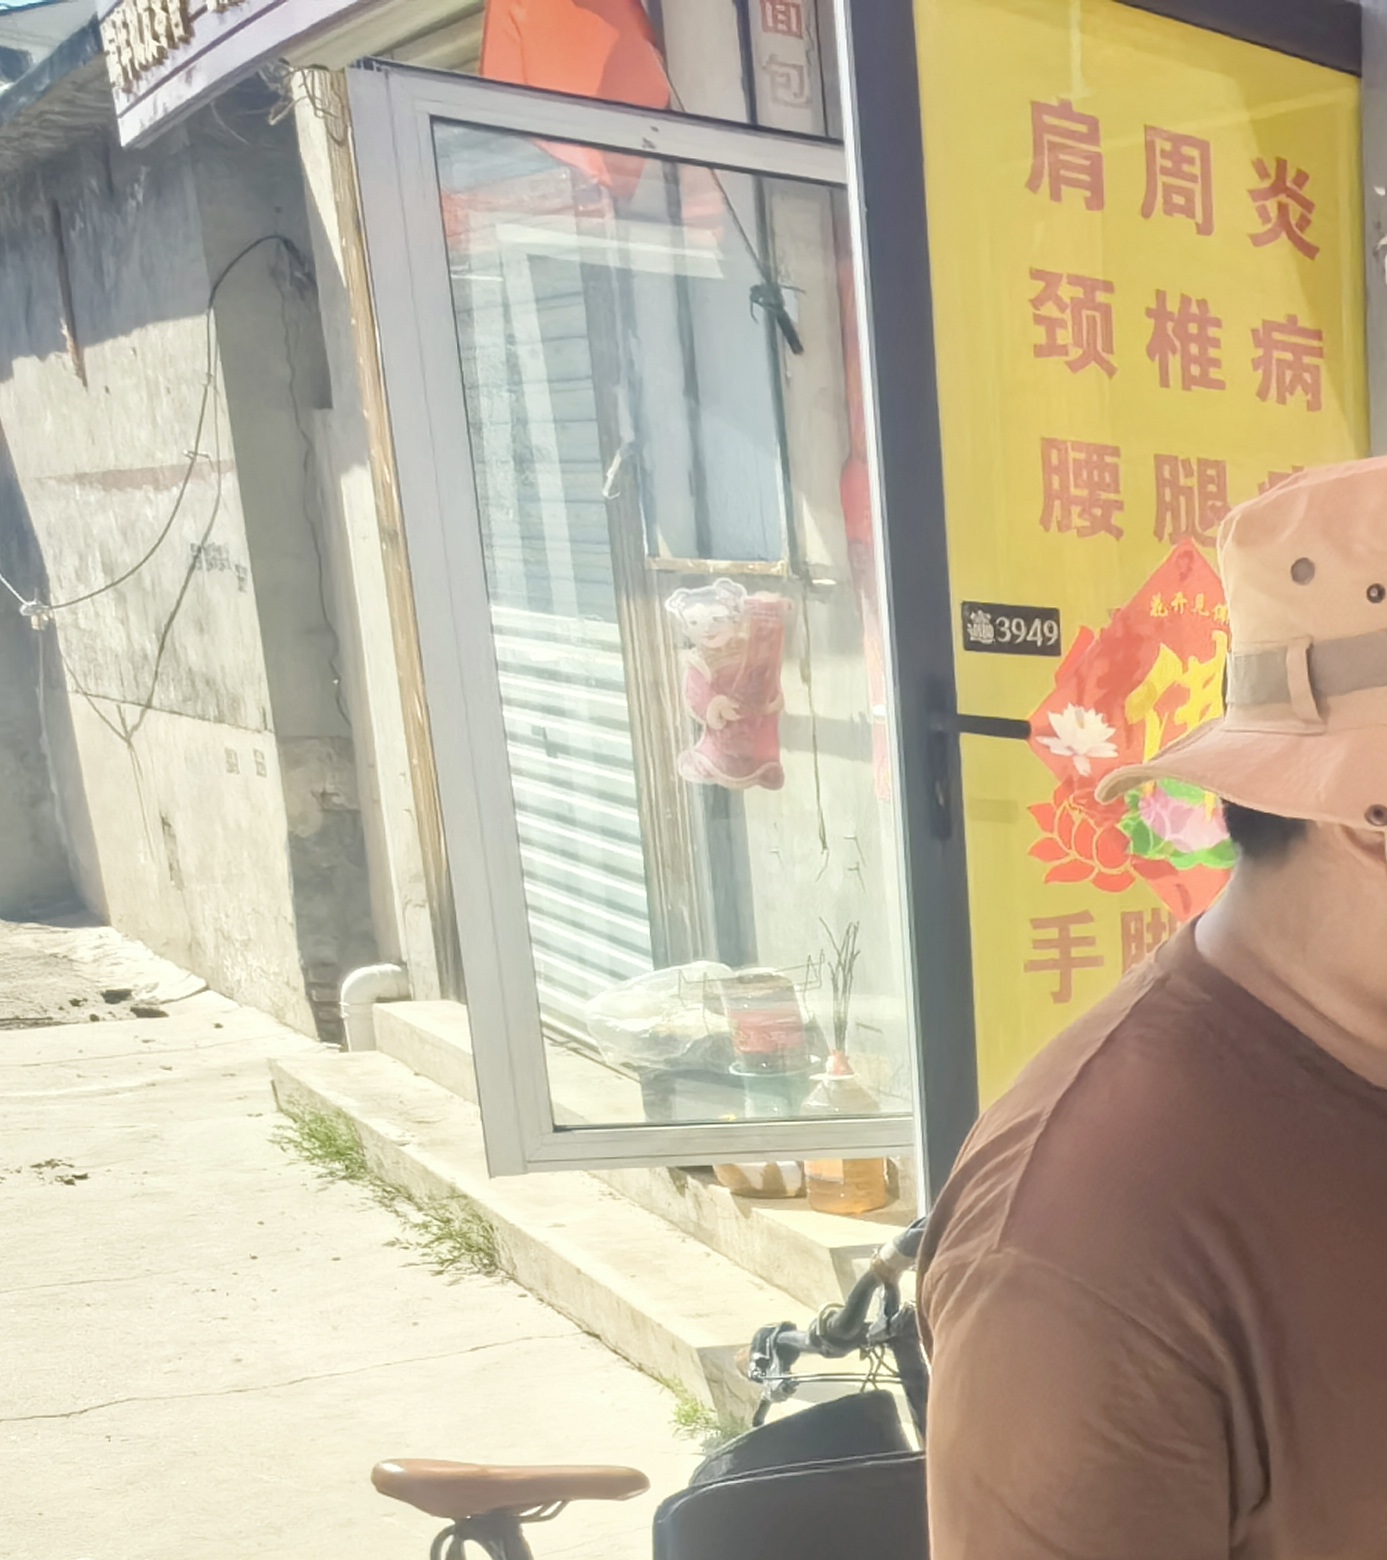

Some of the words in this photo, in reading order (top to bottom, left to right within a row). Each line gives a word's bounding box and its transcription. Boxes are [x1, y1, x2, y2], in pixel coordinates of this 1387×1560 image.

[1024, 97, 1320, 261] 肩周炎
[1028, 266, 1325, 412] 颈椎病
[1039, 437, 1304, 547] 腰腿
[995, 616, 1059, 648] 3949
